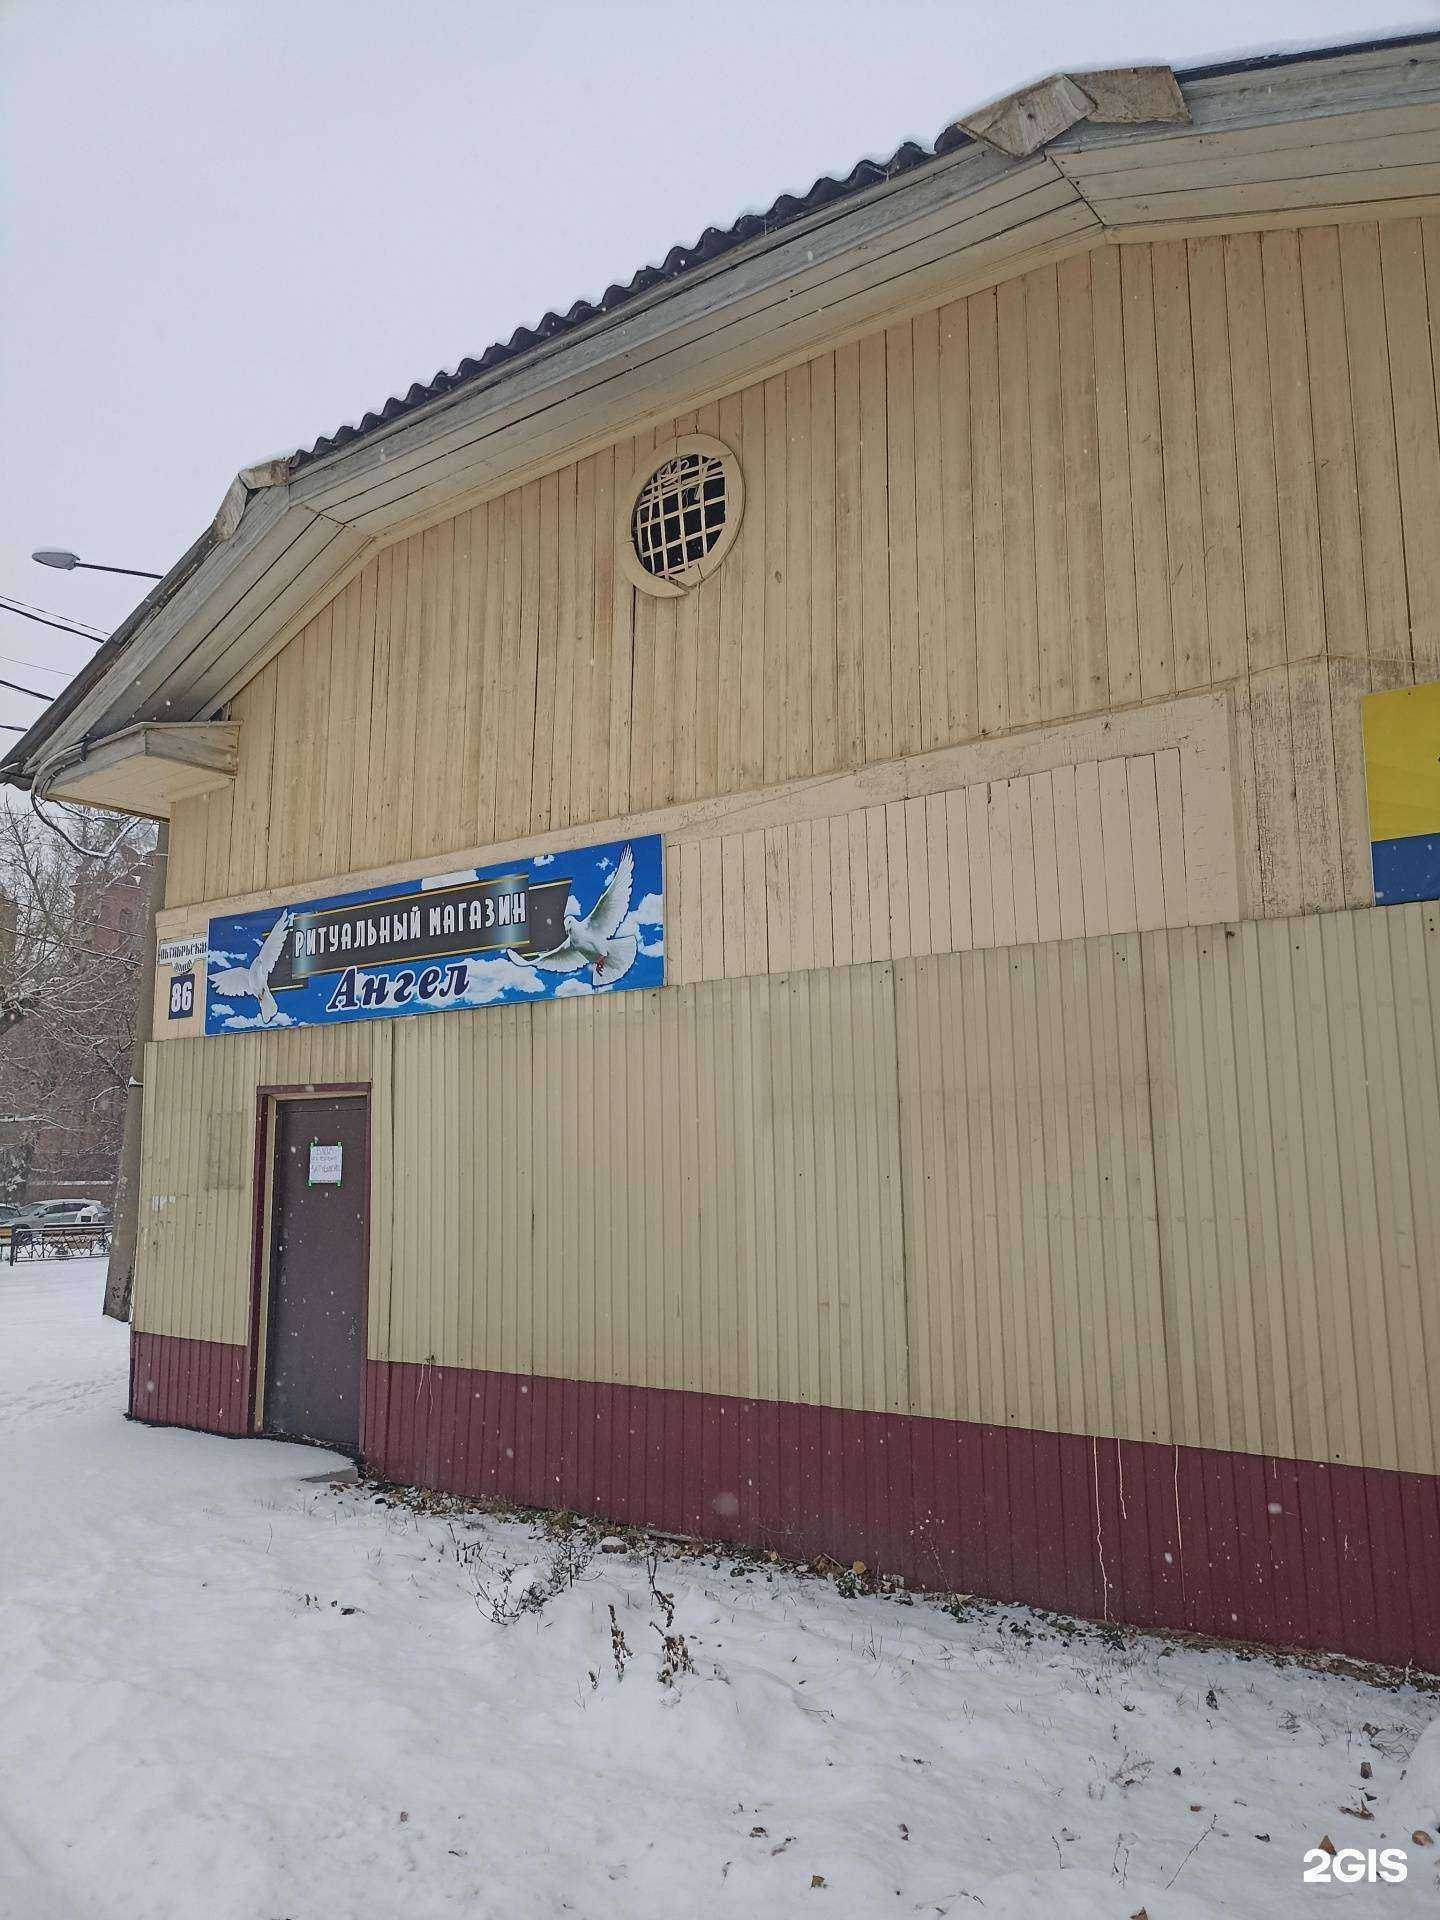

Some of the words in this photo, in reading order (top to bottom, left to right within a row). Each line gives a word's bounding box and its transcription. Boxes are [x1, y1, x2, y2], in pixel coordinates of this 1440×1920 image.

[295, 906, 421, 958] РИТУАЛЬНЫЙ
[429, 892, 526, 936] МАГАЗИН
[171, 981, 193, 1013] 86
[327, 966, 470, 1013] Ангел
